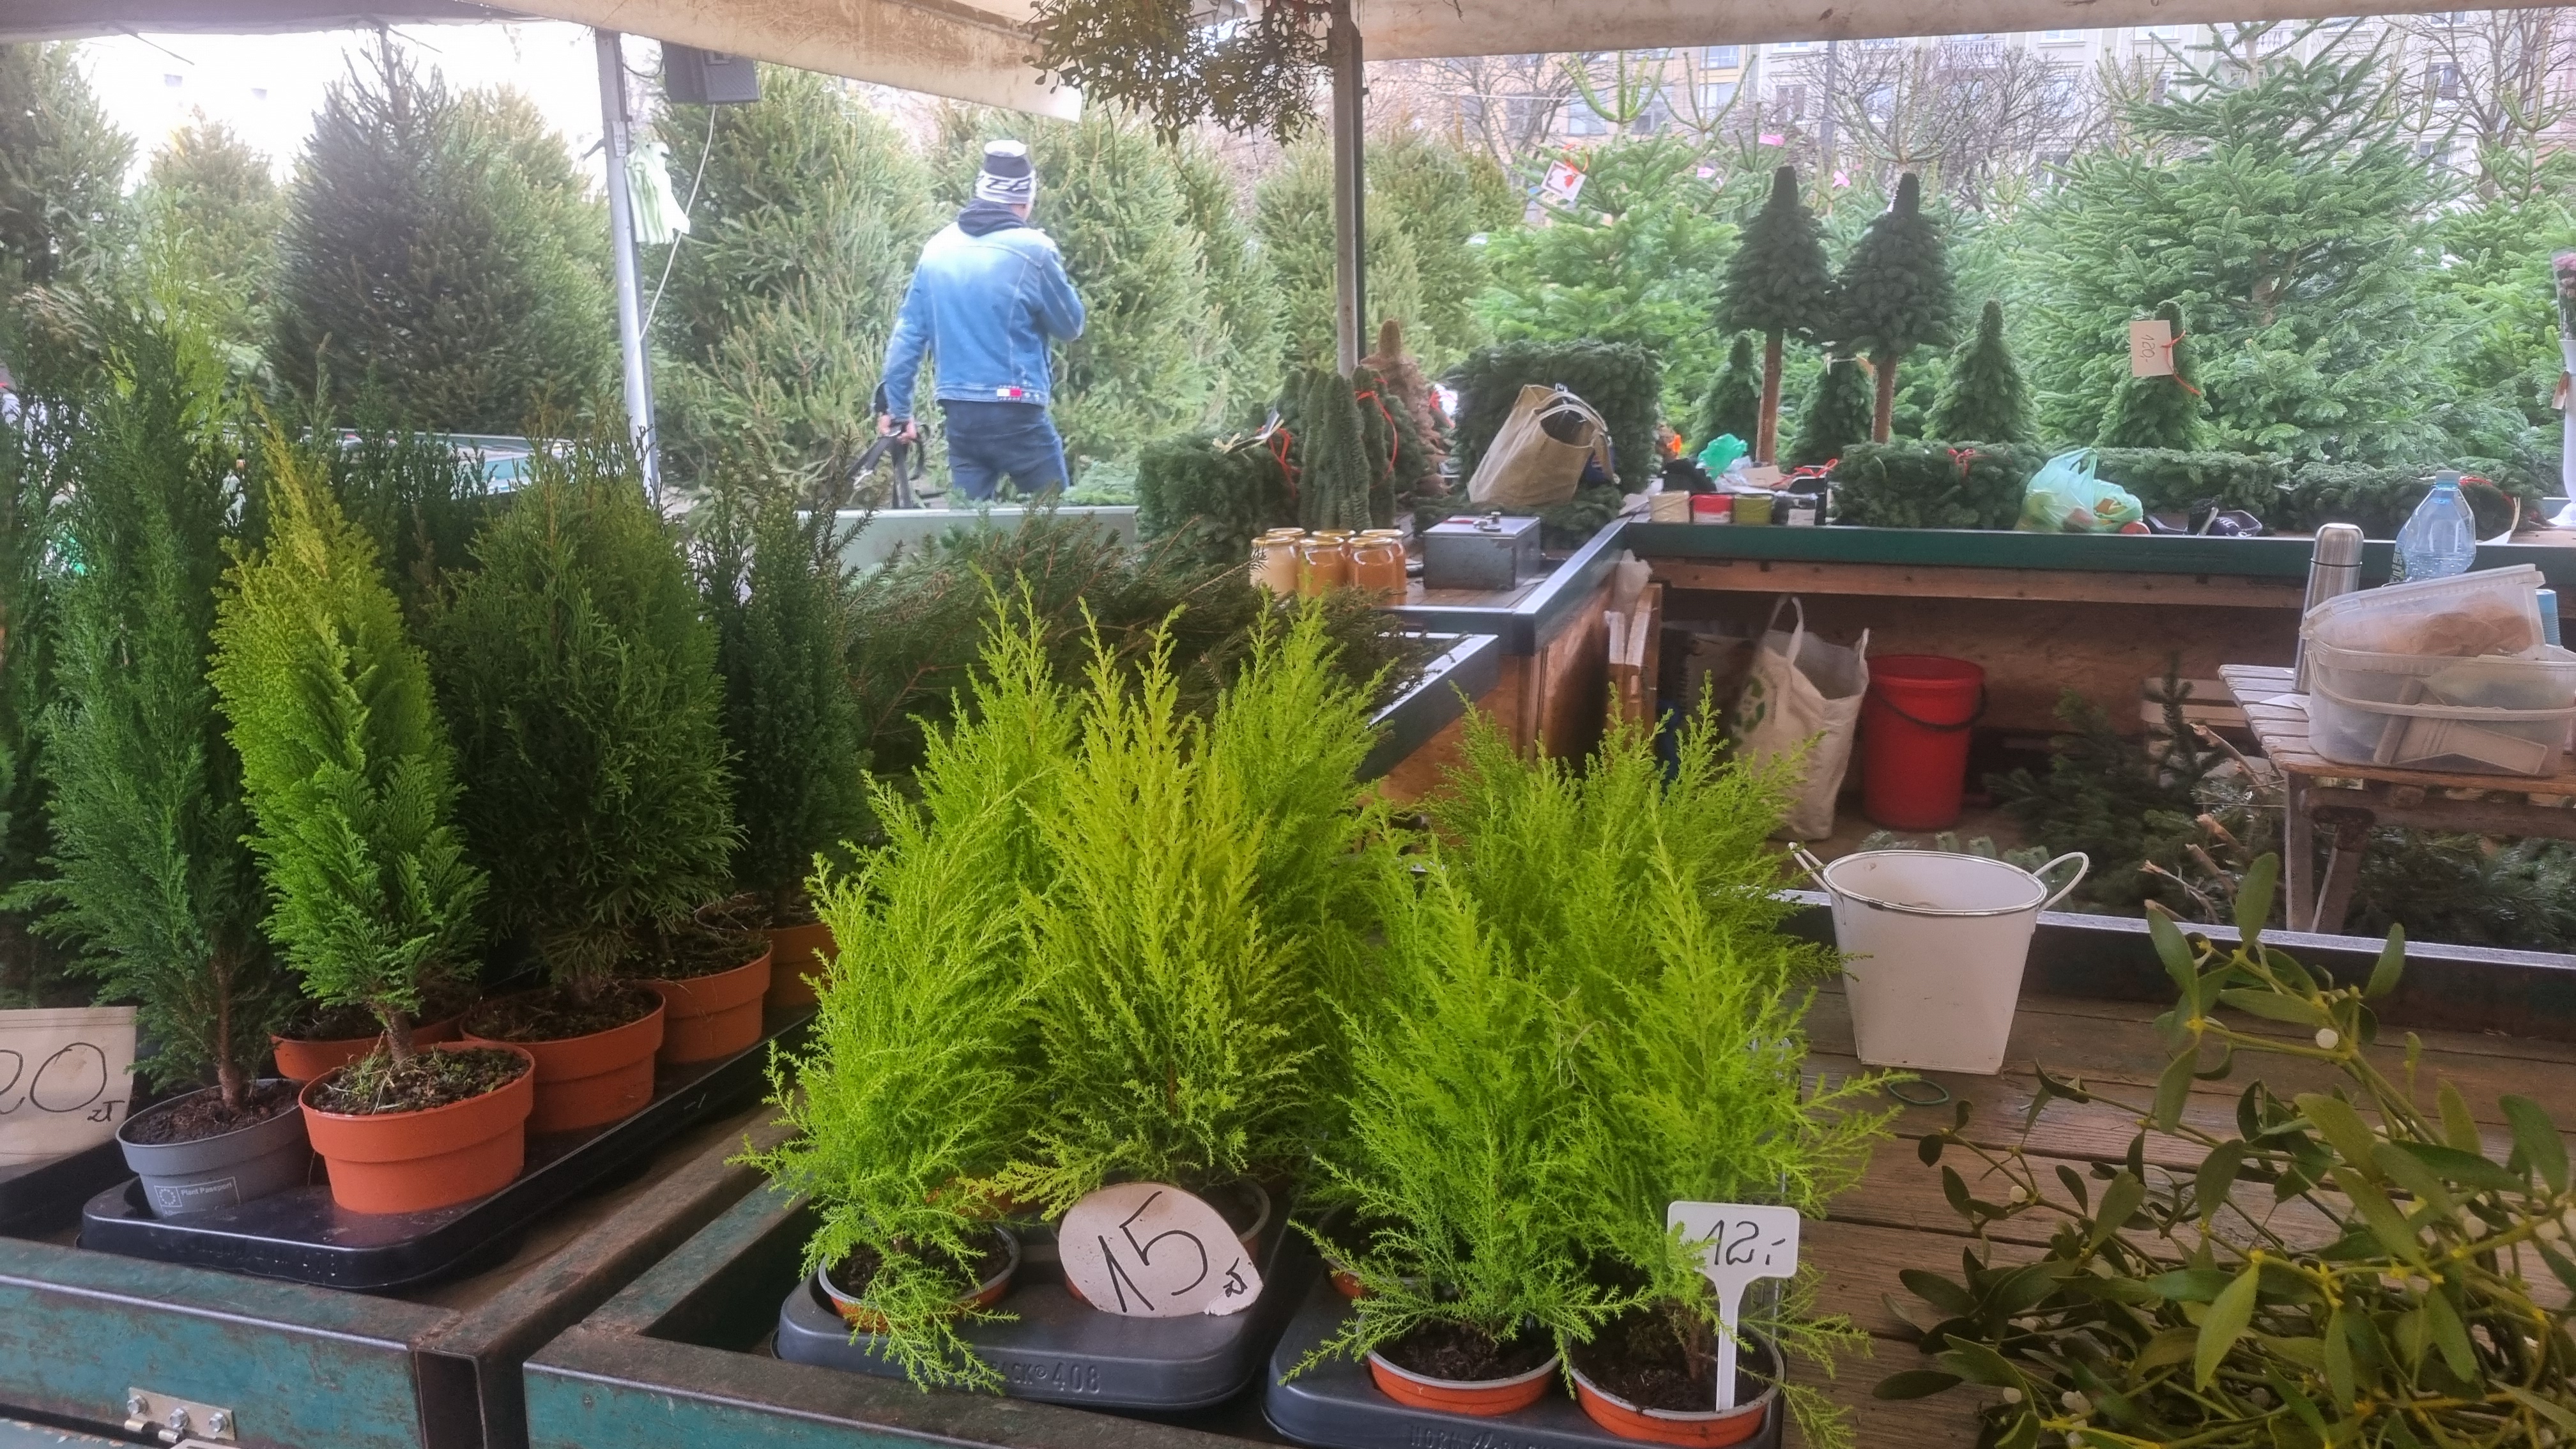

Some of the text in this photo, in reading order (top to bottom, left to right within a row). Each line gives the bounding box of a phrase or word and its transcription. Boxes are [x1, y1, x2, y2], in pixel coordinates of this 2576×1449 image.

[2140, 334, 2156, 363] 120,-
[199, 1181, 233, 1194] Passport
[1098, 1190, 1208, 1313] 15
[1053, 1361, 1101, 1394] 408
